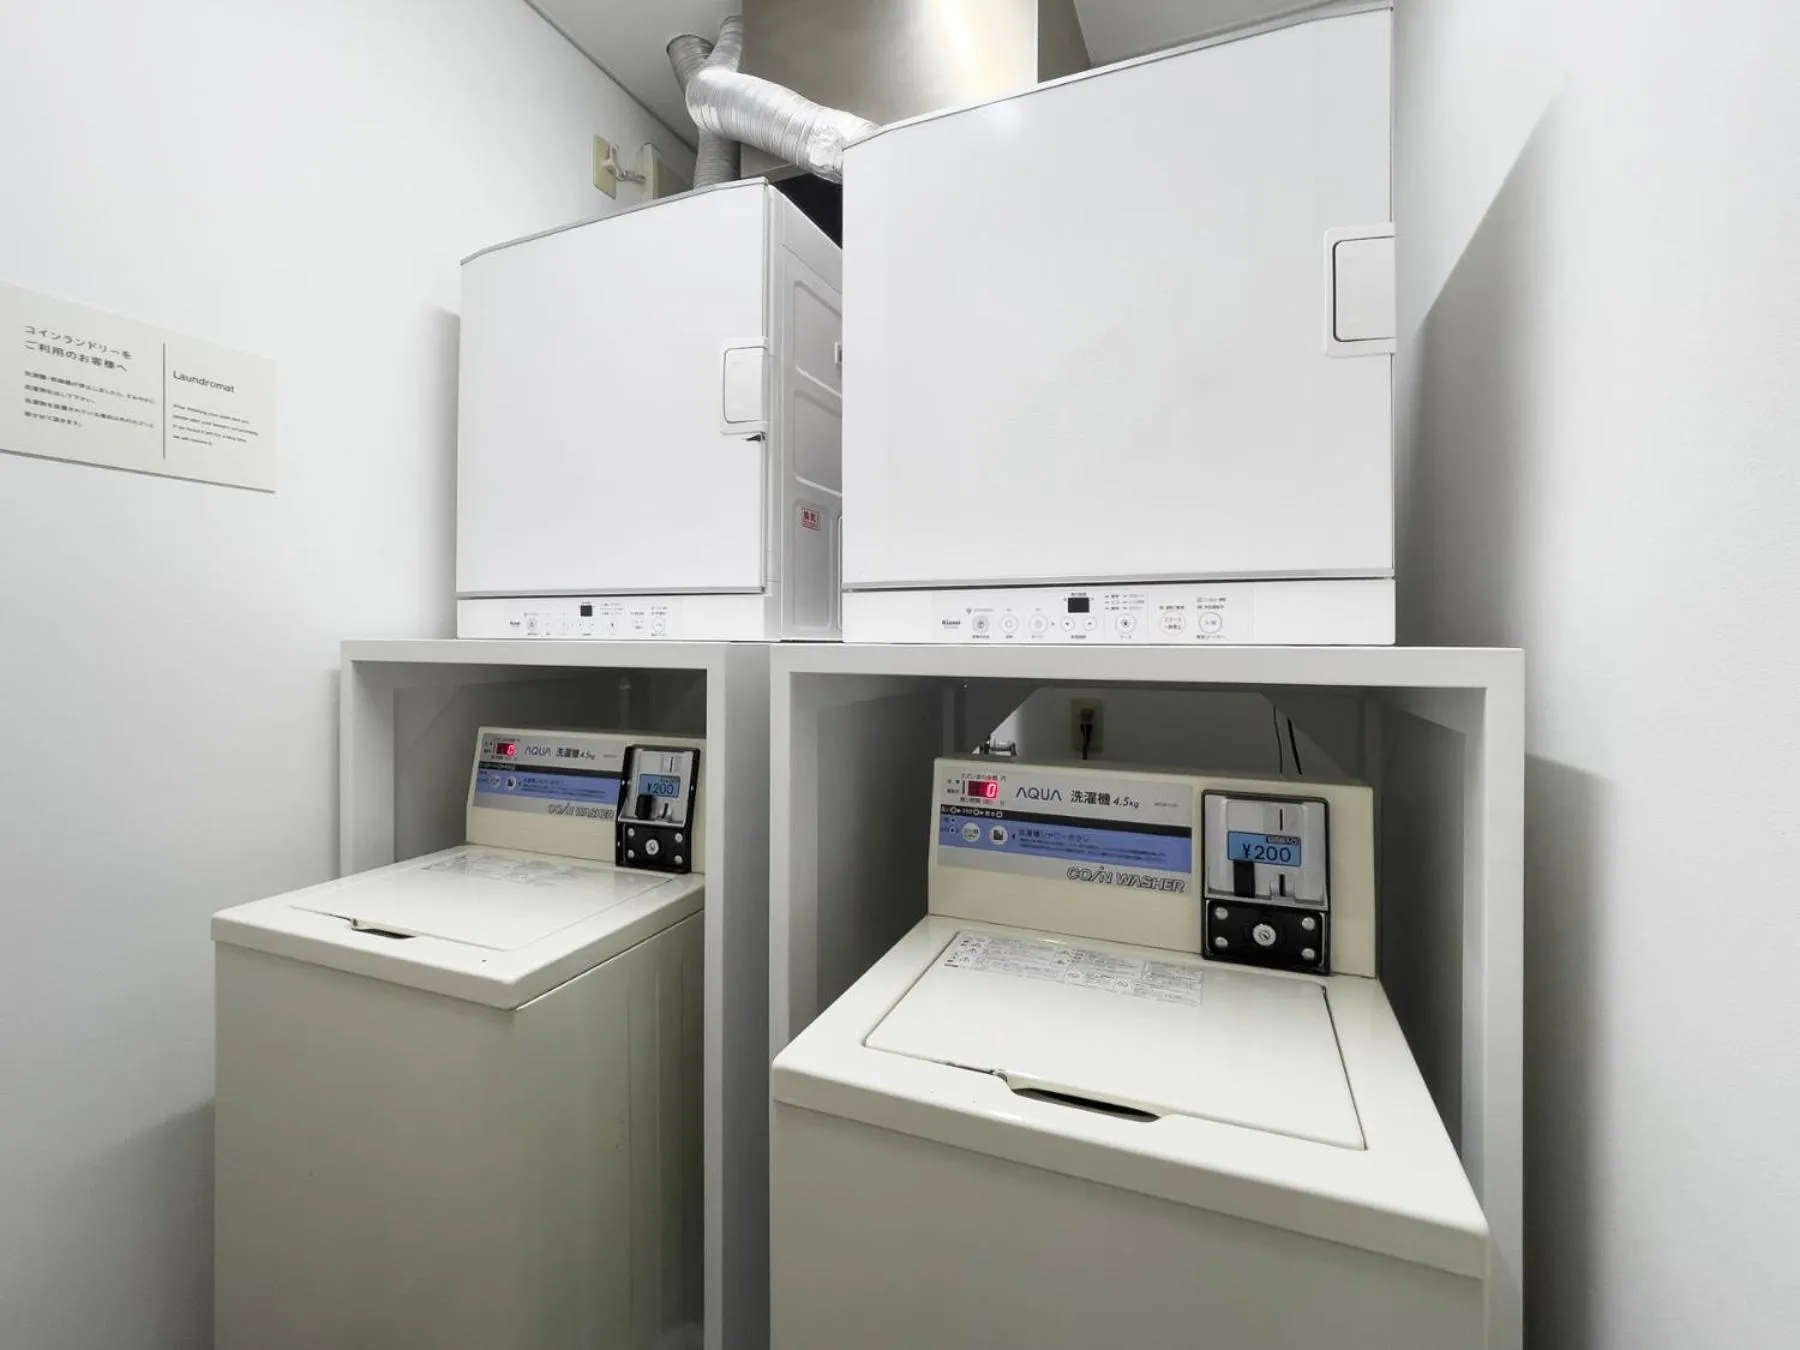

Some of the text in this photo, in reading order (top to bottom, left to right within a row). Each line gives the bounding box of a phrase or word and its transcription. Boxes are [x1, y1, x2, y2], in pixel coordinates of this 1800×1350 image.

[24, 325, 132, 361] コインランドリーを
[24, 339, 128, 372] ご利用のお客様へ
[172, 370, 235, 393] Laundromat
[524, 746, 552, 757] AQUA
[646, 782, 674, 795] ¥200
[986, 783, 997, 797] 0
[1015, 786, 1063, 802] AQUA
[1070, 790, 1111, 806] 洗濯機
[1113, 795, 1140, 809] 4.5kg
[1241, 842, 1292, 863] ¥200
[1117, 873, 1186, 893] WASHER
